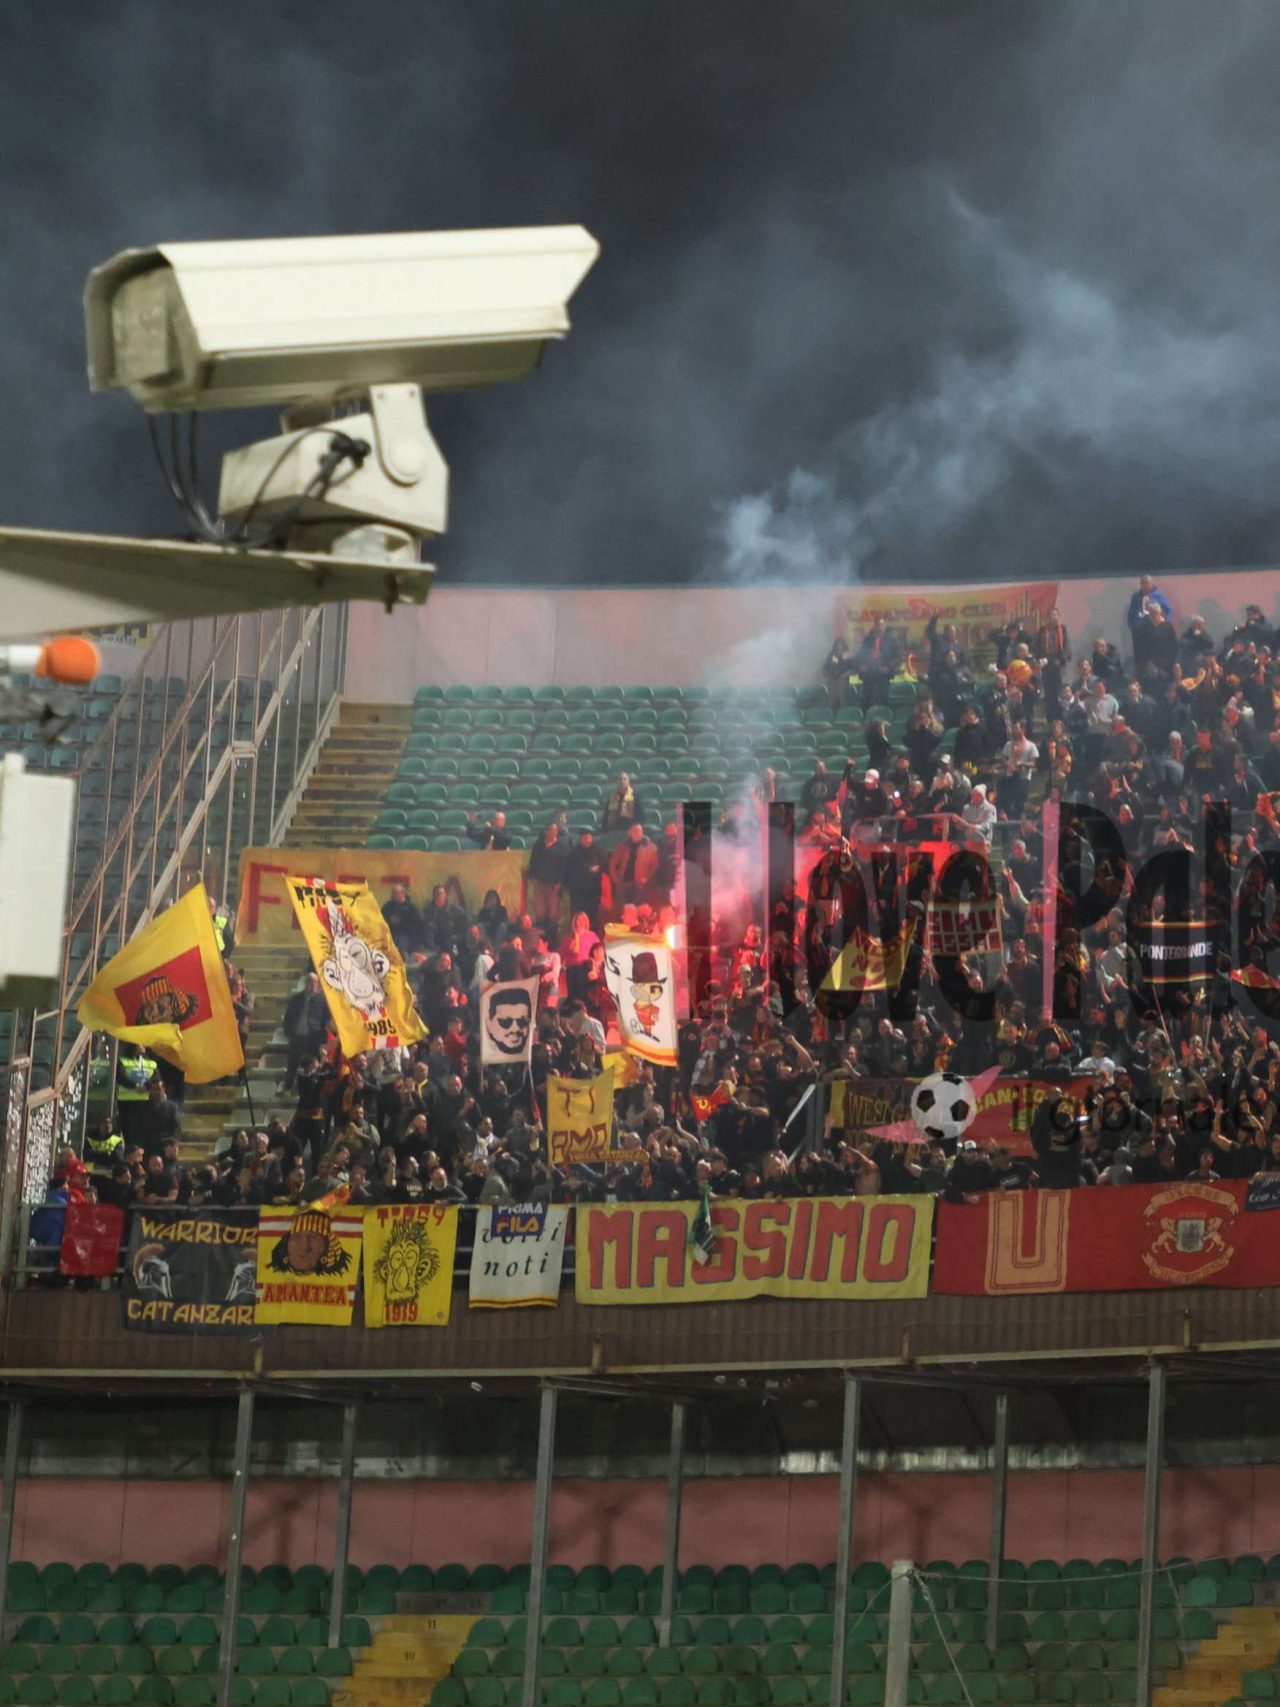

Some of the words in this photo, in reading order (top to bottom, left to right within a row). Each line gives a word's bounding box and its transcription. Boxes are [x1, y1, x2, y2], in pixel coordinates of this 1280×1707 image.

[141, 1216, 258, 1244] WARRIOR
[985, 1189, 1070, 1295] U
[588, 1201, 916, 1289] MASSIMO
[484, 1252, 549, 1277] noti
[127, 1299, 256, 1325] CATANZAR
